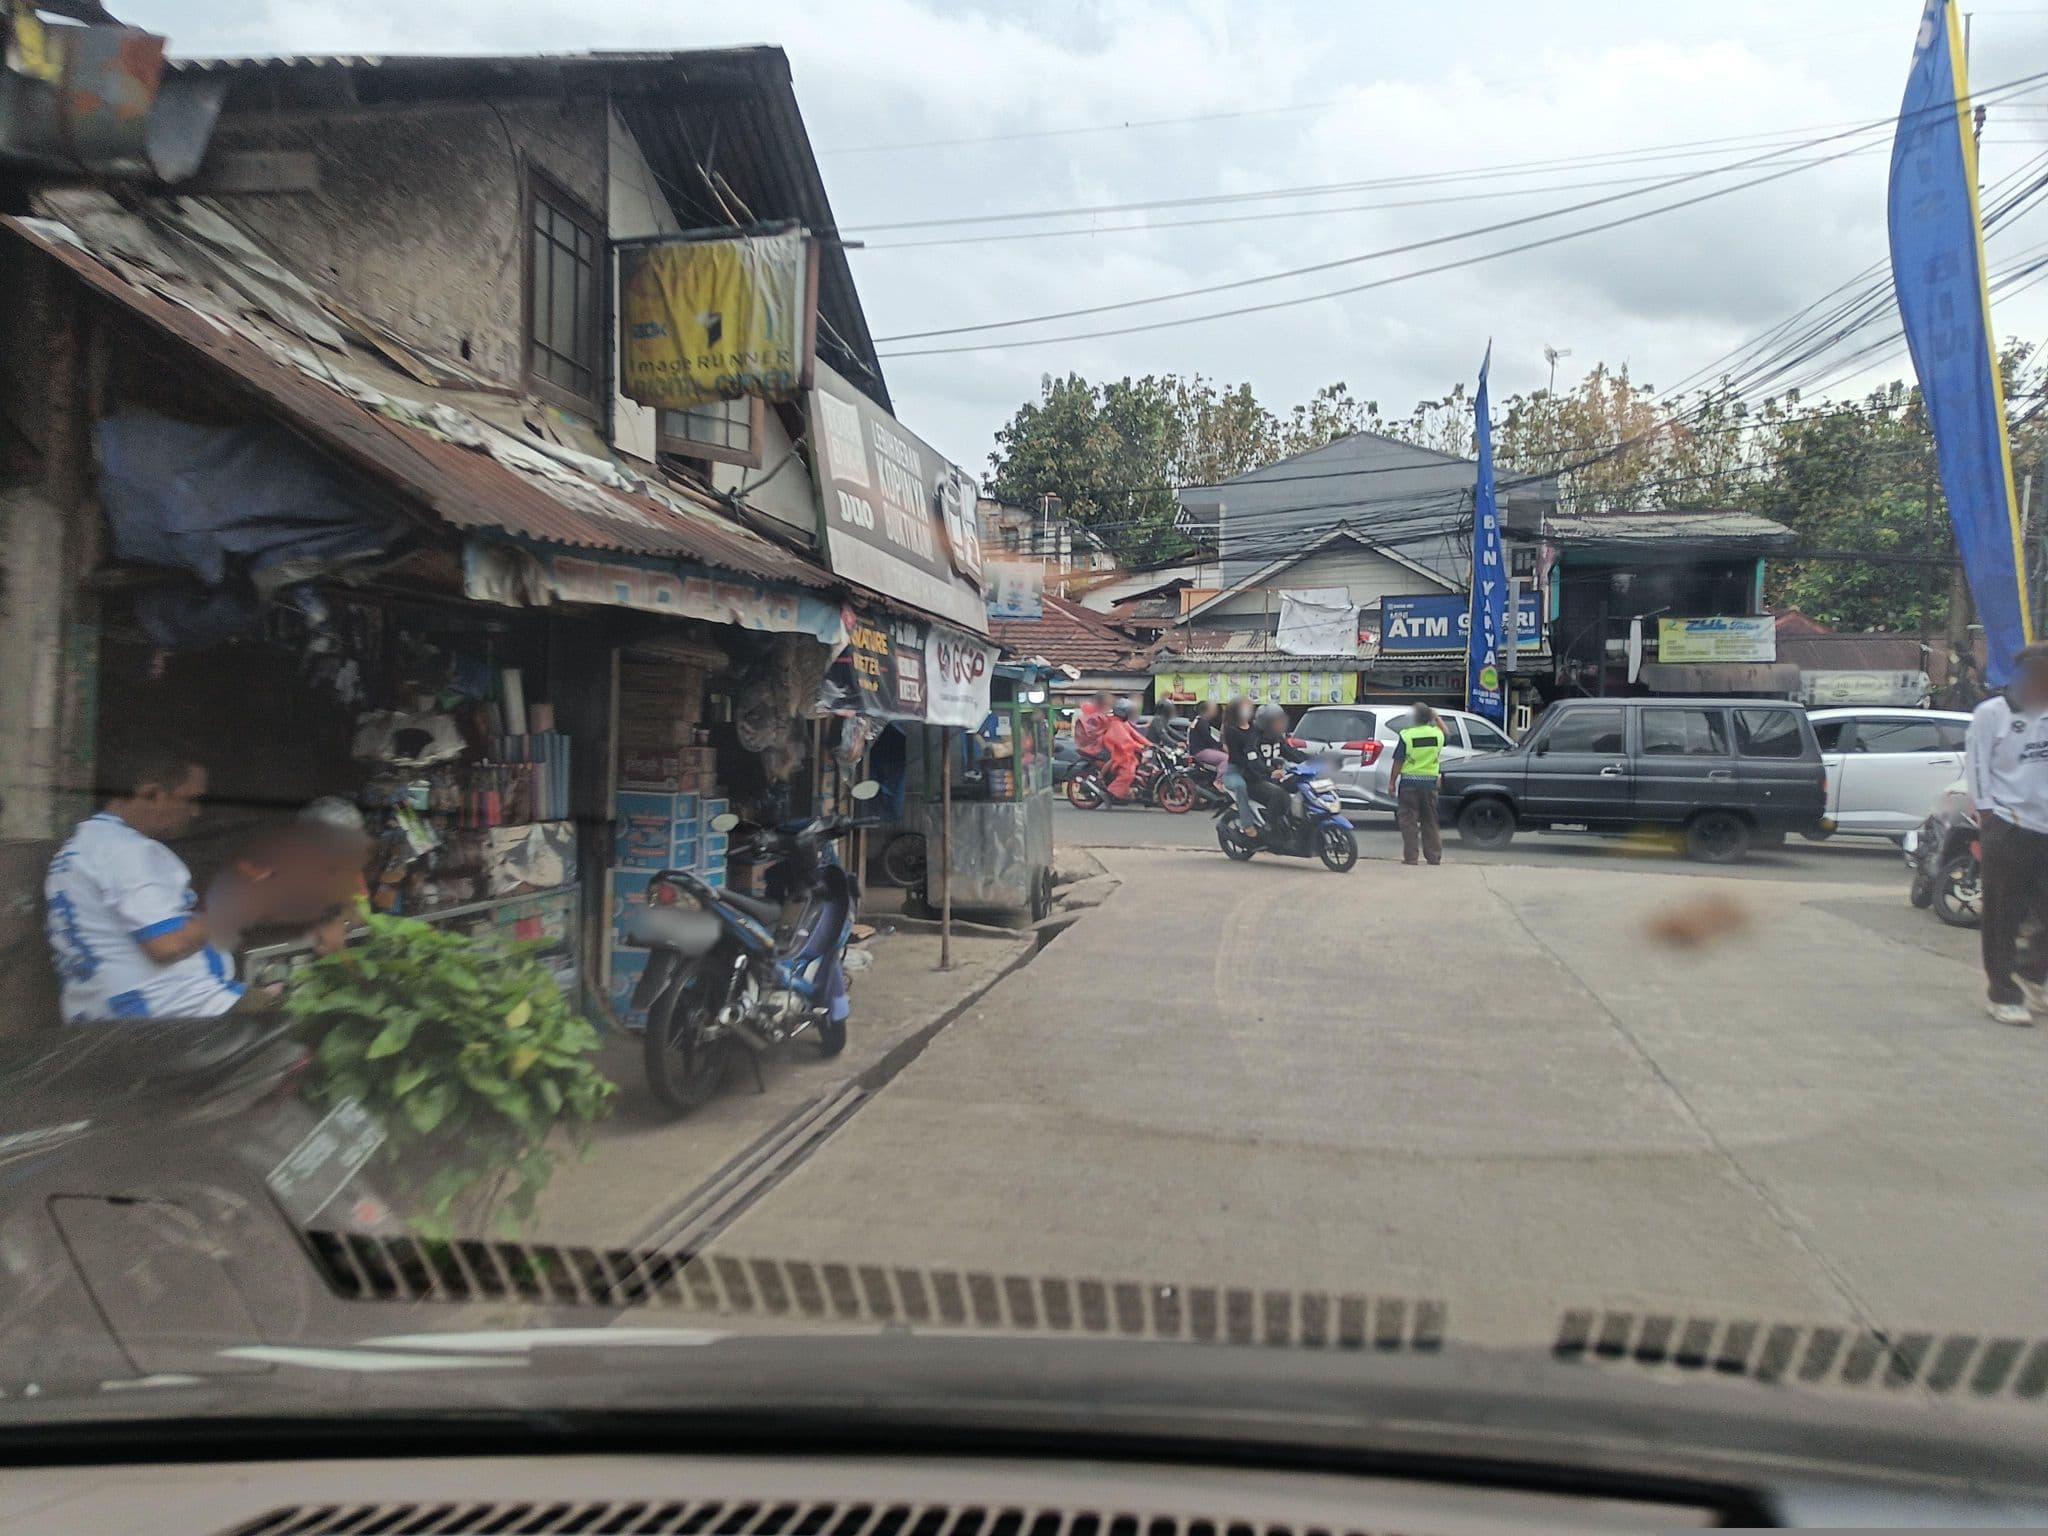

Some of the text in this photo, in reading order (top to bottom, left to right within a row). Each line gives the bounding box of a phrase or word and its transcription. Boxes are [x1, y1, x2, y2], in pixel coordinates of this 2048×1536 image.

[836, 489, 875, 531] DUO
[1483, 514, 1497, 566] BIN
[1387, 611, 1536, 638] ATM GERI
